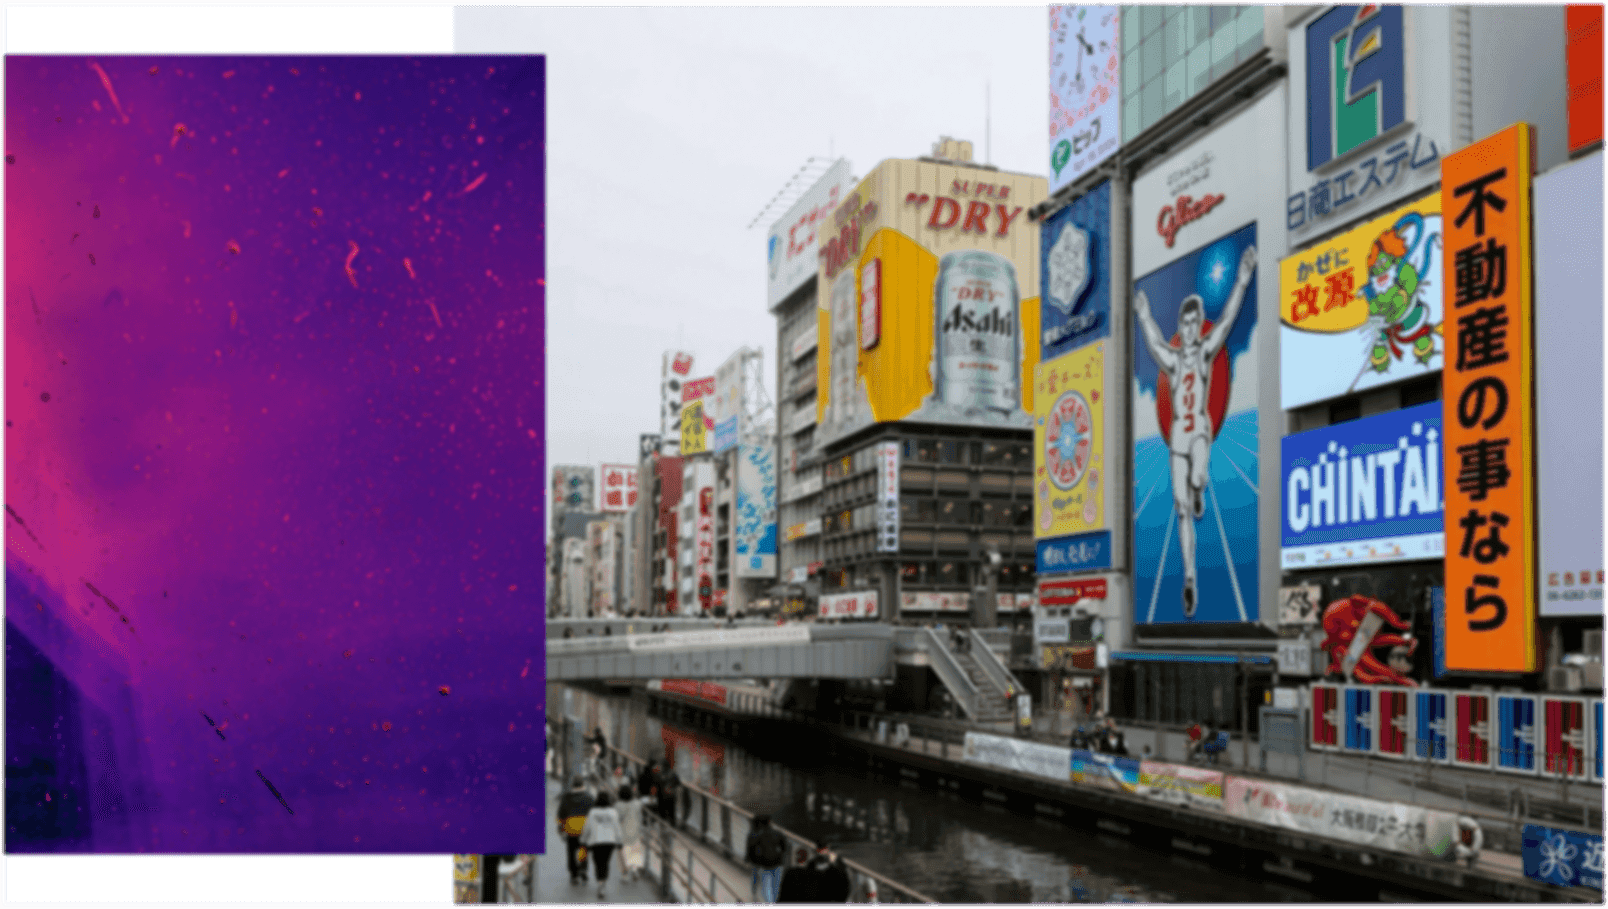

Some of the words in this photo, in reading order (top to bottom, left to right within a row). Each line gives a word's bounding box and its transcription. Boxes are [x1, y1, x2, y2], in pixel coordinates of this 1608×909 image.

[951, 180, 1012, 200] SUPER
[1287, 133, 1439, 232] 日商エステム
[943, 303, 1013, 337] Asahi
[1452, 166, 1512, 633] 不動産の事なら
[1287, 421, 1439, 533] CHINTAI
